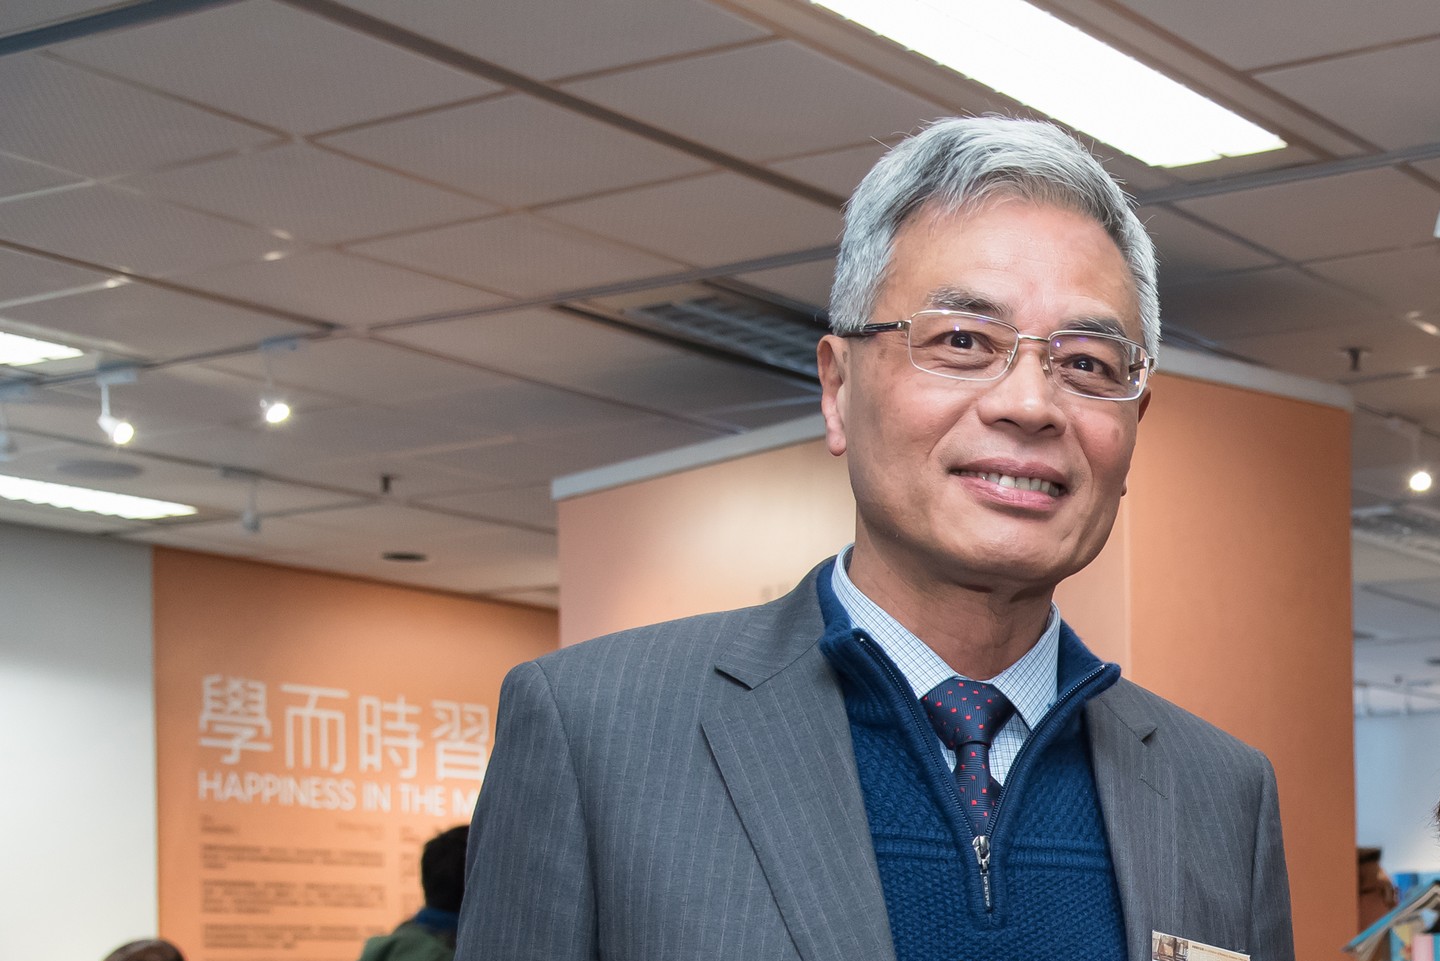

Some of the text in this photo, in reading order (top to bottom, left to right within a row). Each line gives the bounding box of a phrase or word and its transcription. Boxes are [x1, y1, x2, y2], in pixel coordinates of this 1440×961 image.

[198, 674, 490, 782] 學而時習
[198, 769, 356, 812] HAPPINESS
[362, 780, 392, 813] IN
[398, 782, 446, 817] THE
